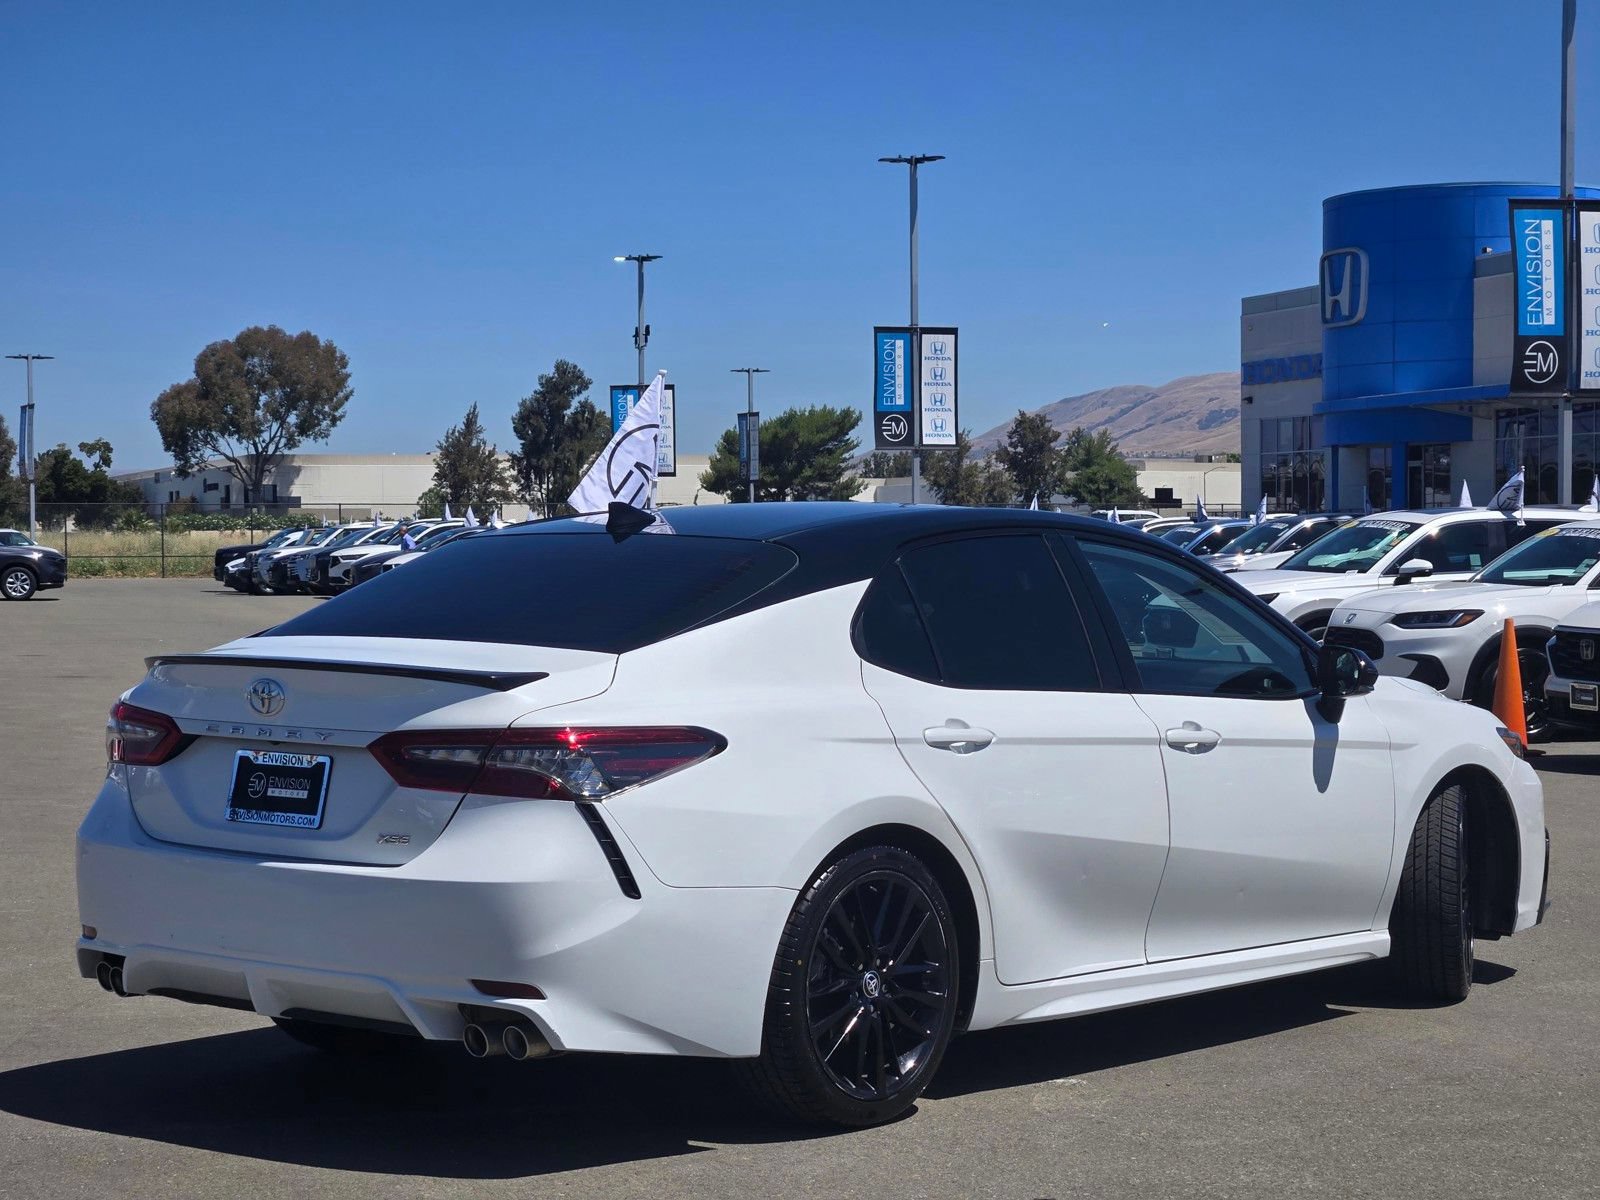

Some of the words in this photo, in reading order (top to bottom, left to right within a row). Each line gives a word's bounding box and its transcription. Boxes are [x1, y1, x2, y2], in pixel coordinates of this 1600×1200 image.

[1523, 219, 1543, 325] ENVISION
[1544, 229, 1553, 317] MOTORS
[883, 339, 895, 406] ENVISION
[205, 723, 335, 741] CAMRY
[262, 753, 304, 766] ENVISION
[268, 776, 311, 790] ENVISION
[228, 808, 316, 827] ENVISIONMOTORS.COM
